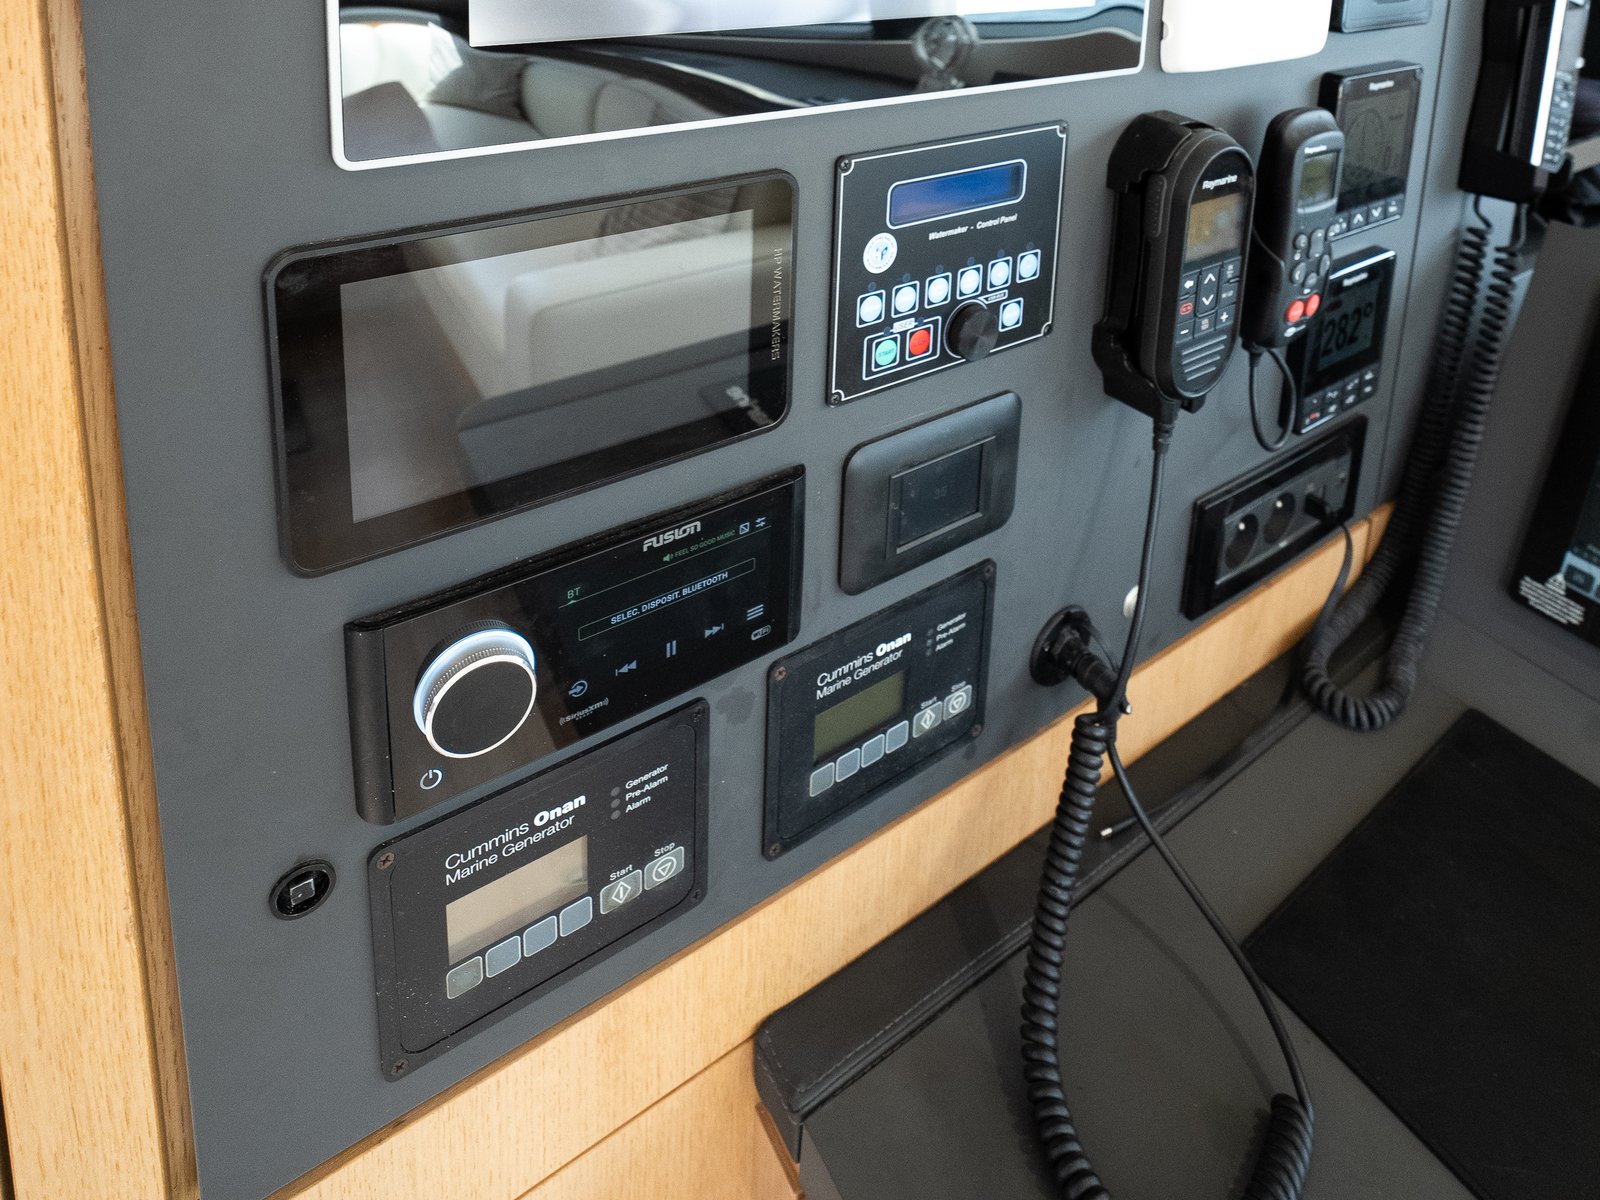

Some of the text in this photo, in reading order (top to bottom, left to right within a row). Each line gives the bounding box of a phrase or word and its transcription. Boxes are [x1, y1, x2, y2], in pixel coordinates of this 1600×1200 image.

[1202, 173, 1238, 191] Raymarine
[928, 224, 969, 242] Watermaker
[976, 216, 1000, 230] Control
[1000, 213, 1018, 226] Panel
[771, 266, 782, 360] WATERMAKERS
[643, 521, 701, 552] FUSION
[674, 530, 736, 558] FEEL SO GOOD MUSIC
[567, 586, 581, 599] BT
[610, 571, 728, 624] SELEC. DISPOSIT. BLUETOOTH
[816, 632, 912, 686] Cummins Onan
[816, 649, 904, 700] Marine Generator
[625, 764, 669, 790] Generator
[625, 775, 669, 802] Pre-Alarm
[625, 796, 652, 814] Alarm
[445, 795, 586, 870] Cummins Onan
[445, 814, 576, 886] Marine Generator
[654, 842, 676, 858] Stop
[610, 864, 634, 881] Start
